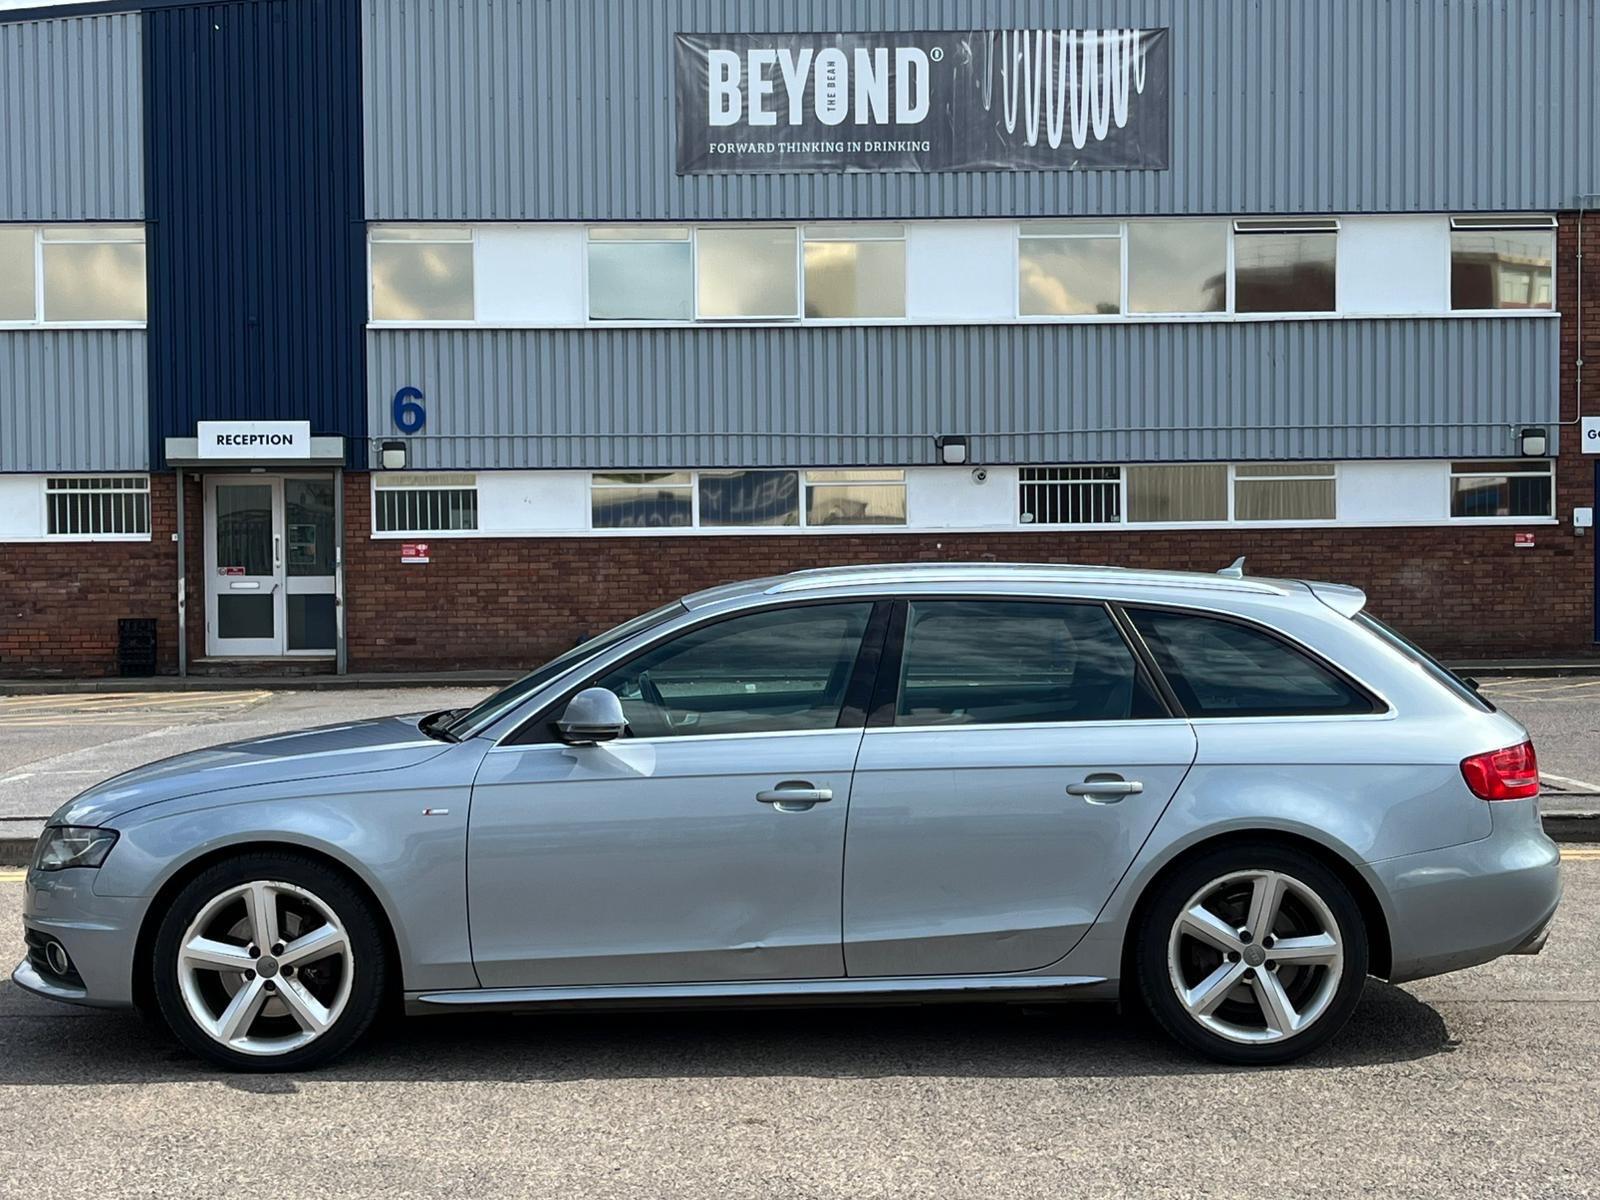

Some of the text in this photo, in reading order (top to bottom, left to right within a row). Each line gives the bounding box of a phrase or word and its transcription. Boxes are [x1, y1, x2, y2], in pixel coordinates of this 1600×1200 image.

[708, 47, 930, 126] BEYOND
[827, 61, 836, 112] THE BEAN
[709, 140, 930, 154] FORWARD THINKING IN DRINKING
[394, 386, 426, 433] 6
[216, 434, 293, 446] RECEPTION
[1587, 429, 1600, 440] G
